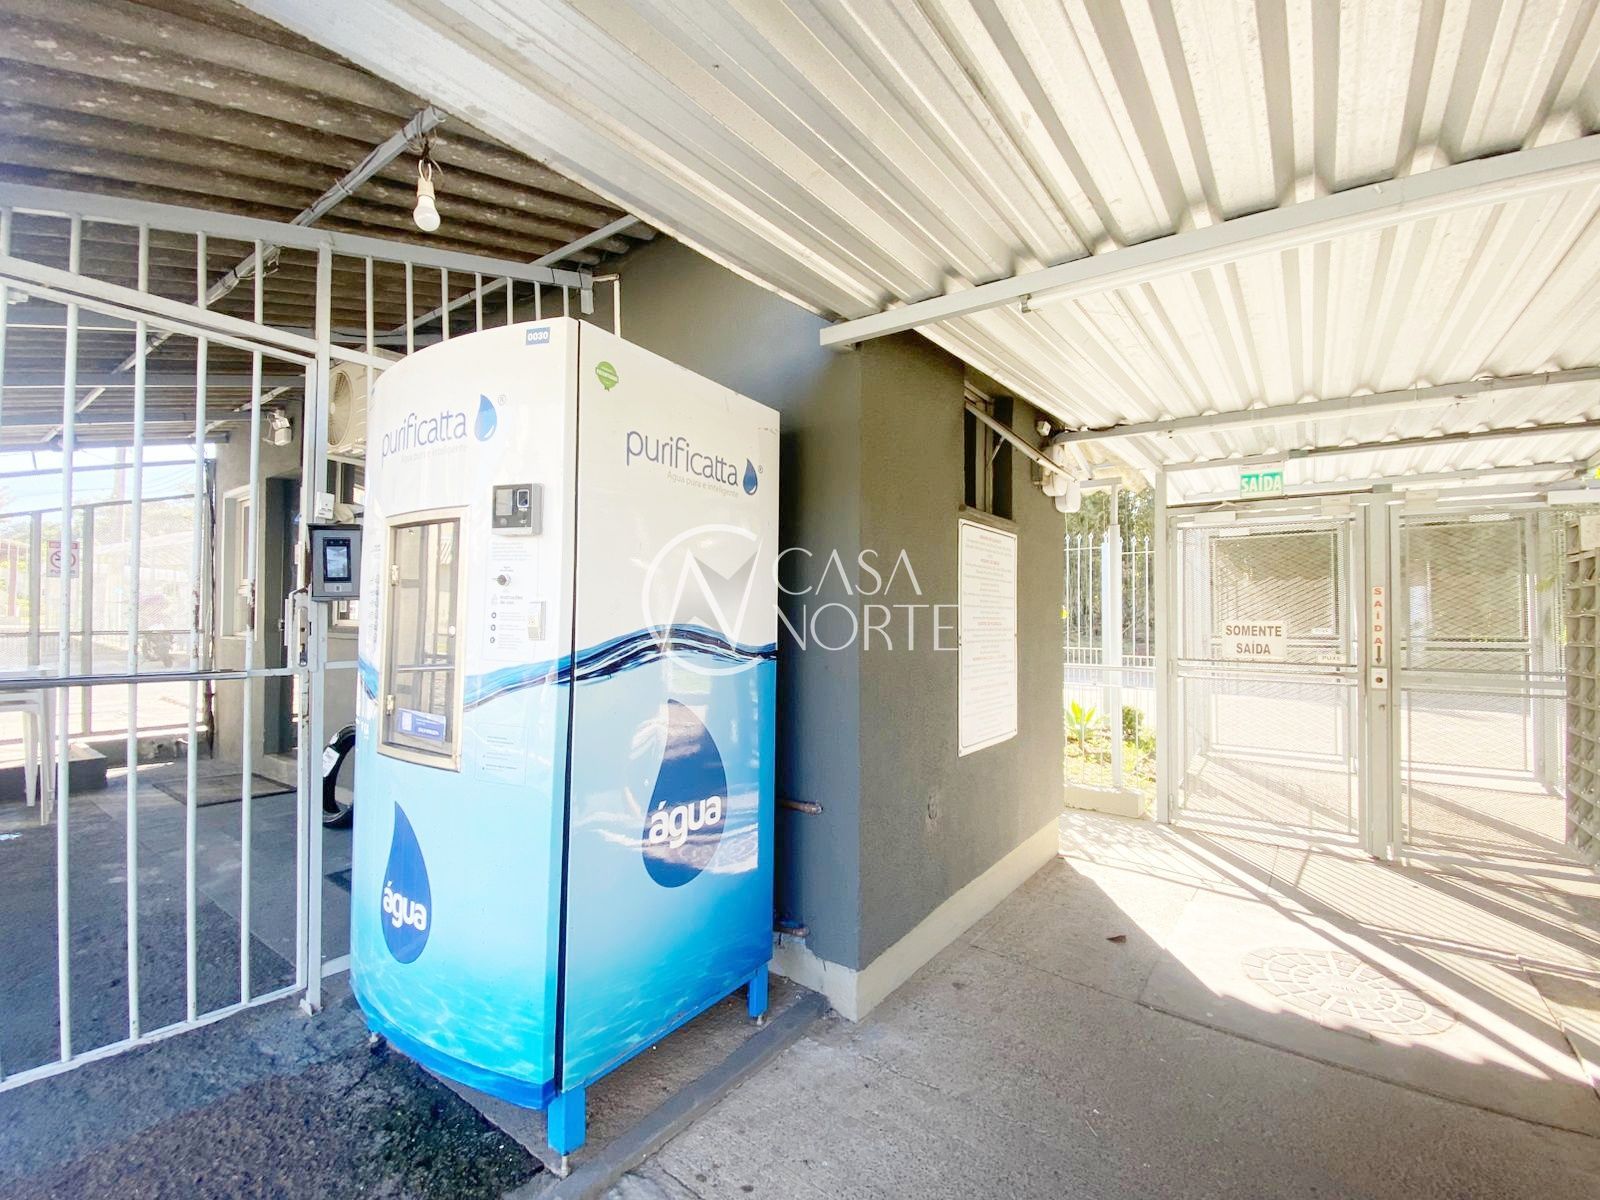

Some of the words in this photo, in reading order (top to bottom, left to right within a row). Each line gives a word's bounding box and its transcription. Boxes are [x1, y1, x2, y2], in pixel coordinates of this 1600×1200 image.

[381, 409, 468, 469] purificatta
[626, 431, 739, 486] purificatta
[1241, 473, 1281, 492] SAÍDA
[1225, 625, 1282, 638] SOMENTE
[1236, 640, 1271, 654] SAÍDA
[649, 796, 722, 849] água
[382, 881, 427, 932] água
